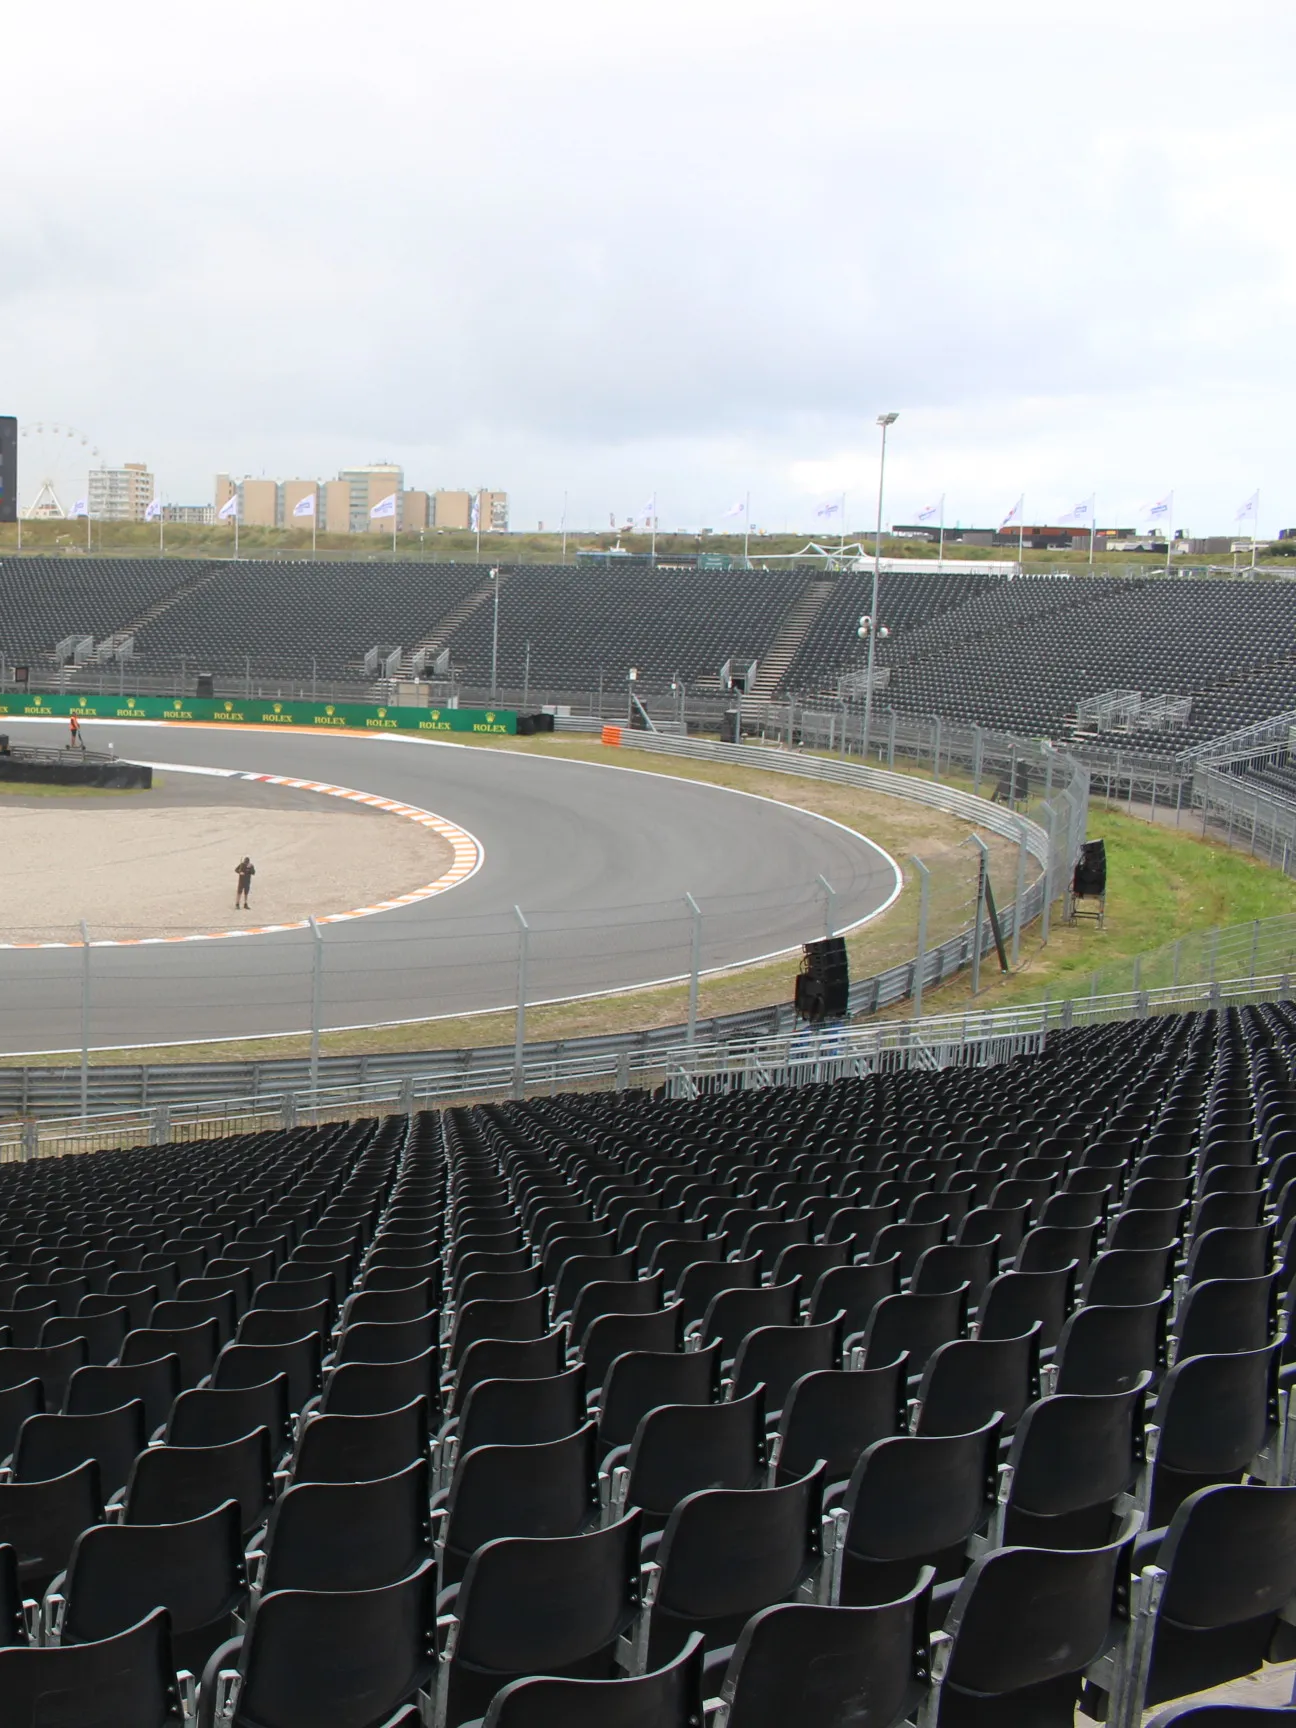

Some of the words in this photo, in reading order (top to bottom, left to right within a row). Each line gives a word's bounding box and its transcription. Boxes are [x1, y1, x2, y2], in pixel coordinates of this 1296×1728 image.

[117, 709, 145, 717] ROLEX
[164, 711, 192, 719] ROLEX
[214, 712, 244, 720] ROLEX
[262, 714, 292, 723] ROLEX
[314, 716, 345, 725] ROLEX
[366, 719, 397, 728] ROLEX
[419, 721, 451, 730] ROLEX
[473, 724, 506, 732] ROLEX
